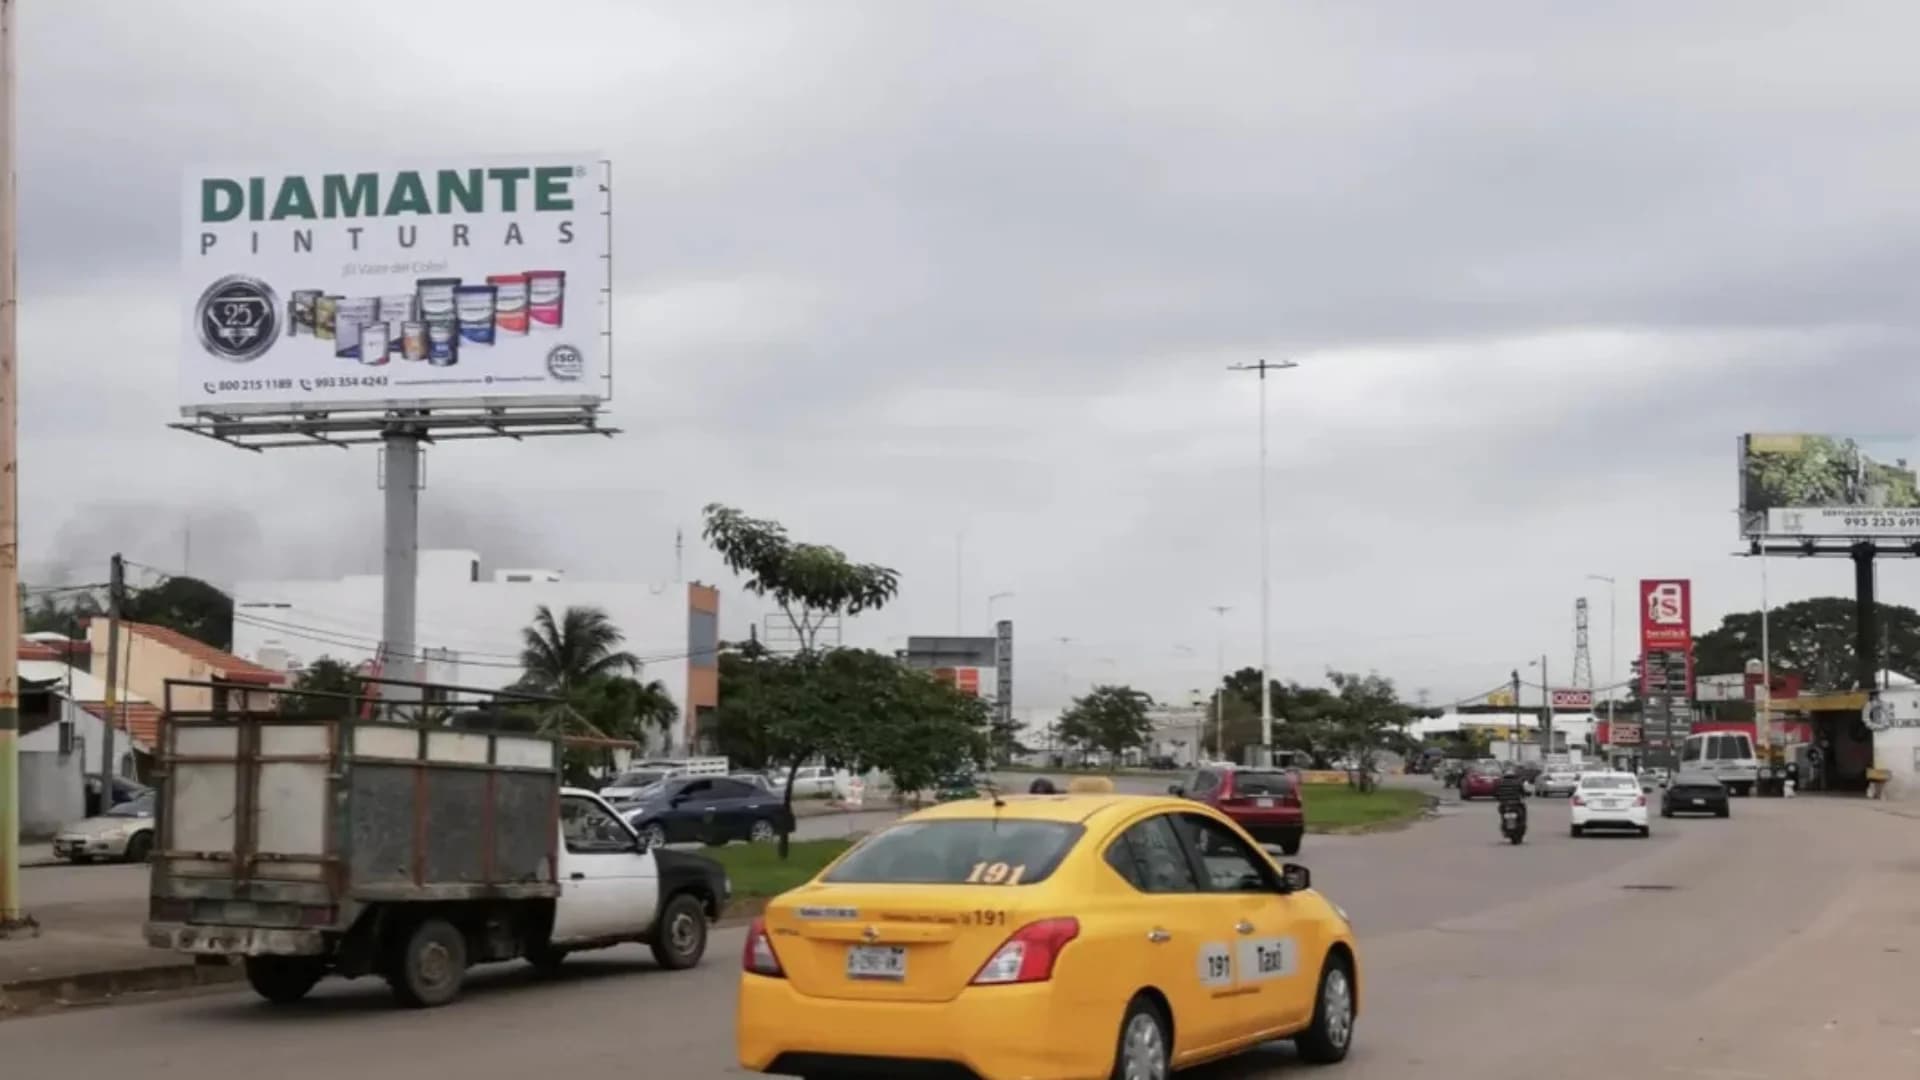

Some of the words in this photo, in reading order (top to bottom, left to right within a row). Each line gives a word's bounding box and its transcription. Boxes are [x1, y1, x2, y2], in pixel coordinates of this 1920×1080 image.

[202, 167, 574, 223] DIAMANTE
[201, 220, 574, 256] PINTURAS
[224, 303, 252, 325] 25
[554, 353, 576, 362] ISO
[219, 380, 239, 391] 800
[242, 379, 262, 391] 215
[315, 377, 336, 388] 993
[361, 375, 389, 387] 4243
[1843, 518, 1868, 527] 993
[964, 861, 1026, 886] 191
[974, 909, 1005, 927] 191
[1208, 954, 1230, 978] 191
[1257, 942, 1282, 973] Taxi
